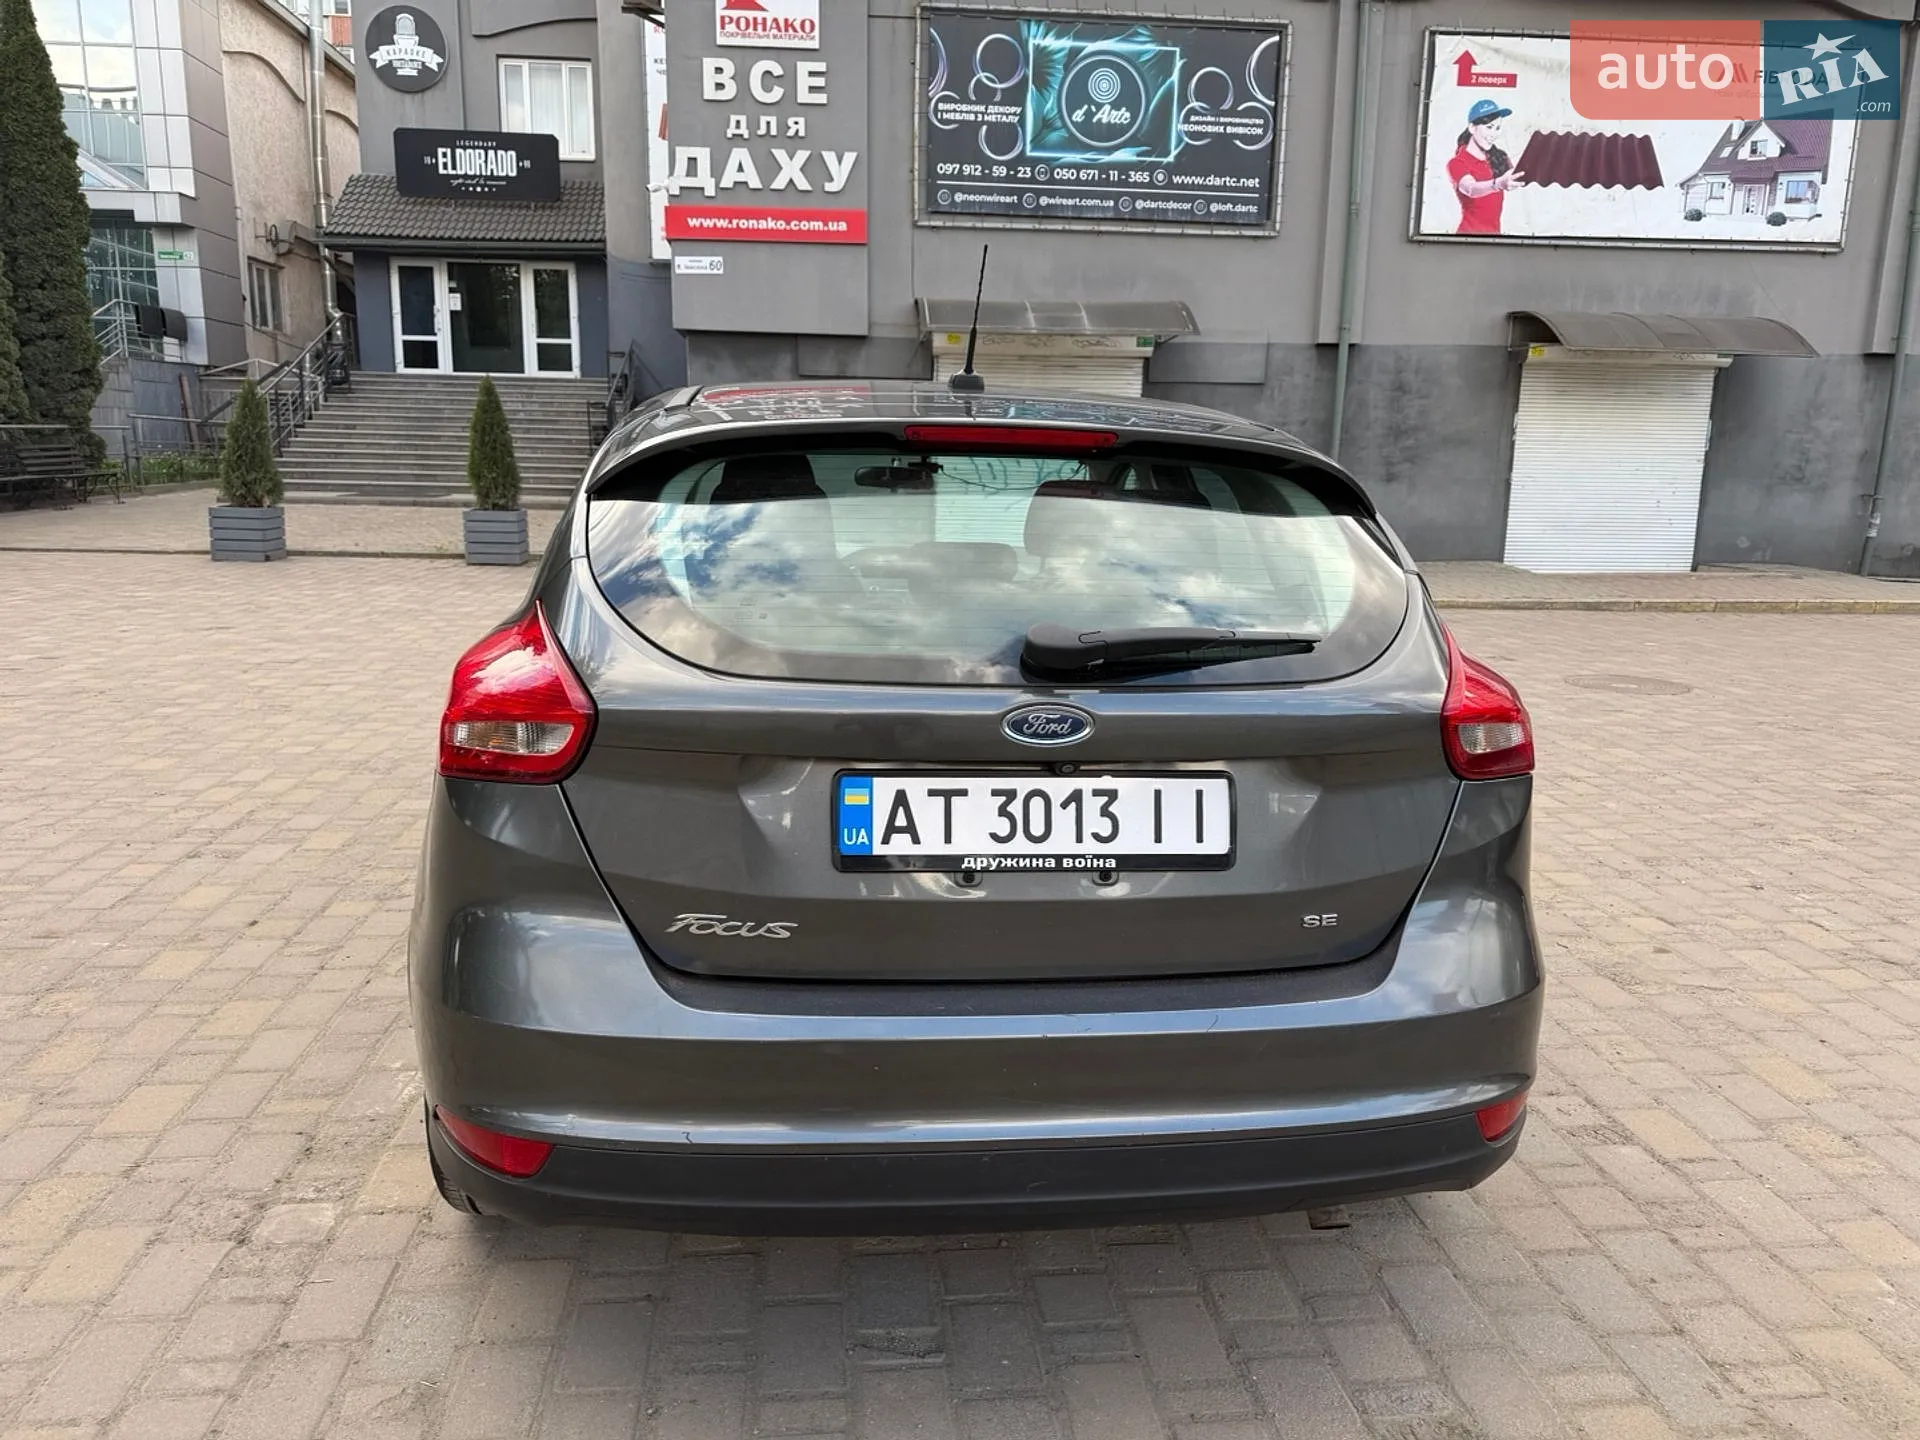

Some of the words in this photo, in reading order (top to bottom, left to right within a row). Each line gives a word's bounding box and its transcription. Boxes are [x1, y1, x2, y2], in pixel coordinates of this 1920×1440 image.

[719, 15, 816, 34] РОНАКО
[702, 57, 828, 104] ВСЕ
[1470, 74, 1477, 84] 2
[1477, 76, 1508, 86] поверх
[937, 102, 987, 112] ВИРОБНИК
[987, 105, 1023, 114] ДЕКОРУ
[942, 112, 976, 120] МЕБЛІВ
[984, 114, 1020, 123] МЕТАЛУ
[437, 147, 518, 177] ELDORADO
[668, 146, 858, 197] ДАХУ
[937, 163, 959, 175] 097
[962, 164, 983, 176] 912
[991, 165, 1007, 177] 59
[1016, 166, 1032, 178] 23
[1053, 168, 1077, 180] 050
[1079, 169, 1099, 181] 671
[1108, 170, 1118, 182] 11
[1128, 171, 1150, 183] 365
[1171, 172, 1260, 188] www.dartc.net
[953, 193, 1018, 204] @neonwireart
[1038, 196, 1114, 207] @wireart.com.ua
[1134, 199, 1192, 211] @dartcdecor
[1209, 201, 1258, 214] @loft.dartc
[686, 216, 848, 232] www.ronako.com.ua
[1022, 713, 1074, 736] Ford
[880, 788, 969, 845] AT
[988, 788, 1120, 845] 3013
[843, 827, 870, 846] UA
[961, 854, 1059, 871] дружина
[1062, 854, 1117, 870] воїна
[1302, 913, 1338, 928] SE
